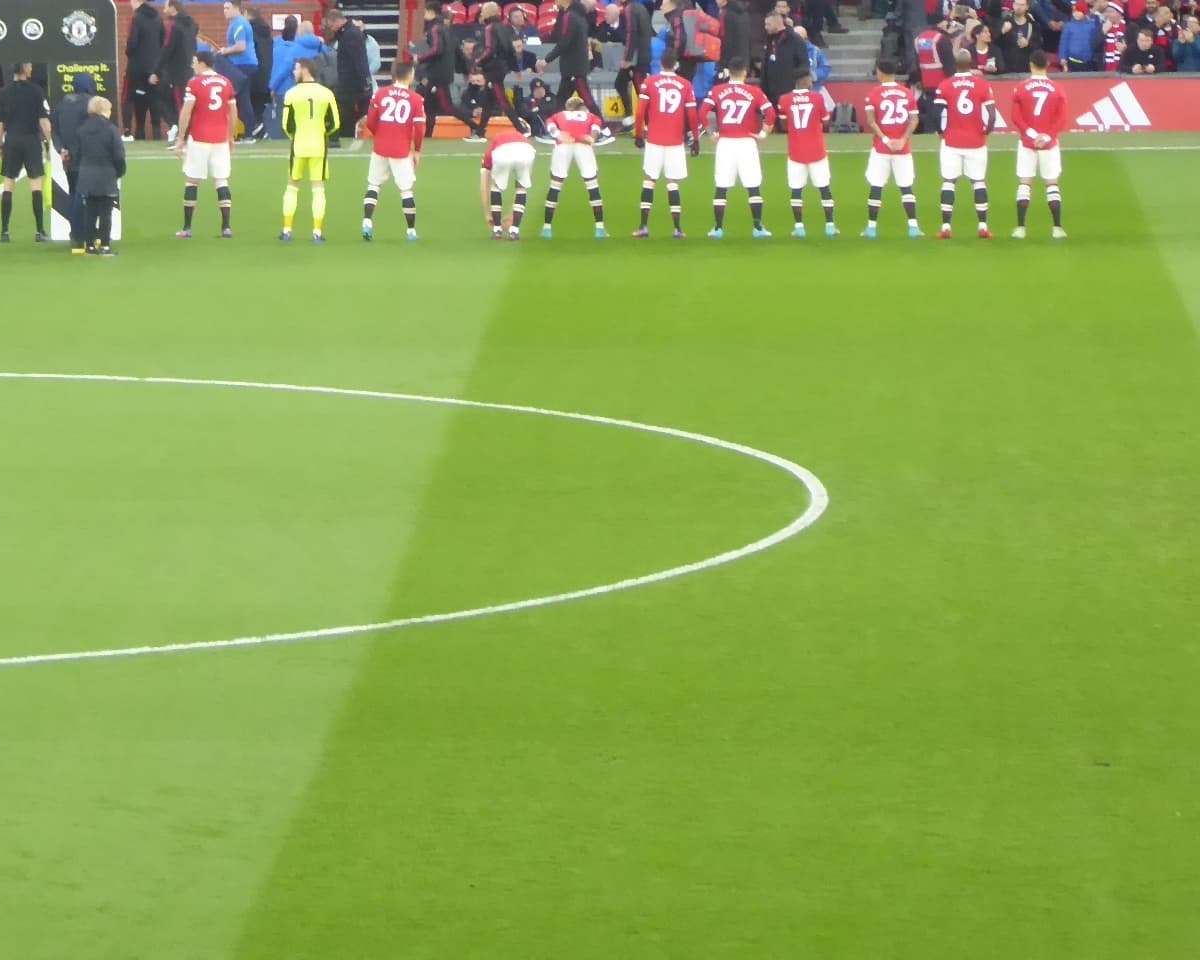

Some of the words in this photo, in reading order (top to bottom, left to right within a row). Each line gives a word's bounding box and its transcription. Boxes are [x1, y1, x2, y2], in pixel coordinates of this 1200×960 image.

[56, 64, 99, 74] Challenge
[208, 86, 223, 111] 5
[307, 98, 314, 119] 1
[380, 96, 411, 124] 20
[610, 102, 619, 114] 4
[658, 87, 682, 114] 19
[720, 98, 752, 125] 27
[880, 98, 909, 125] 25
[957, 89, 974, 115] 6
[1032, 90, 1049, 117] 7
[790, 103, 814, 129] 17
